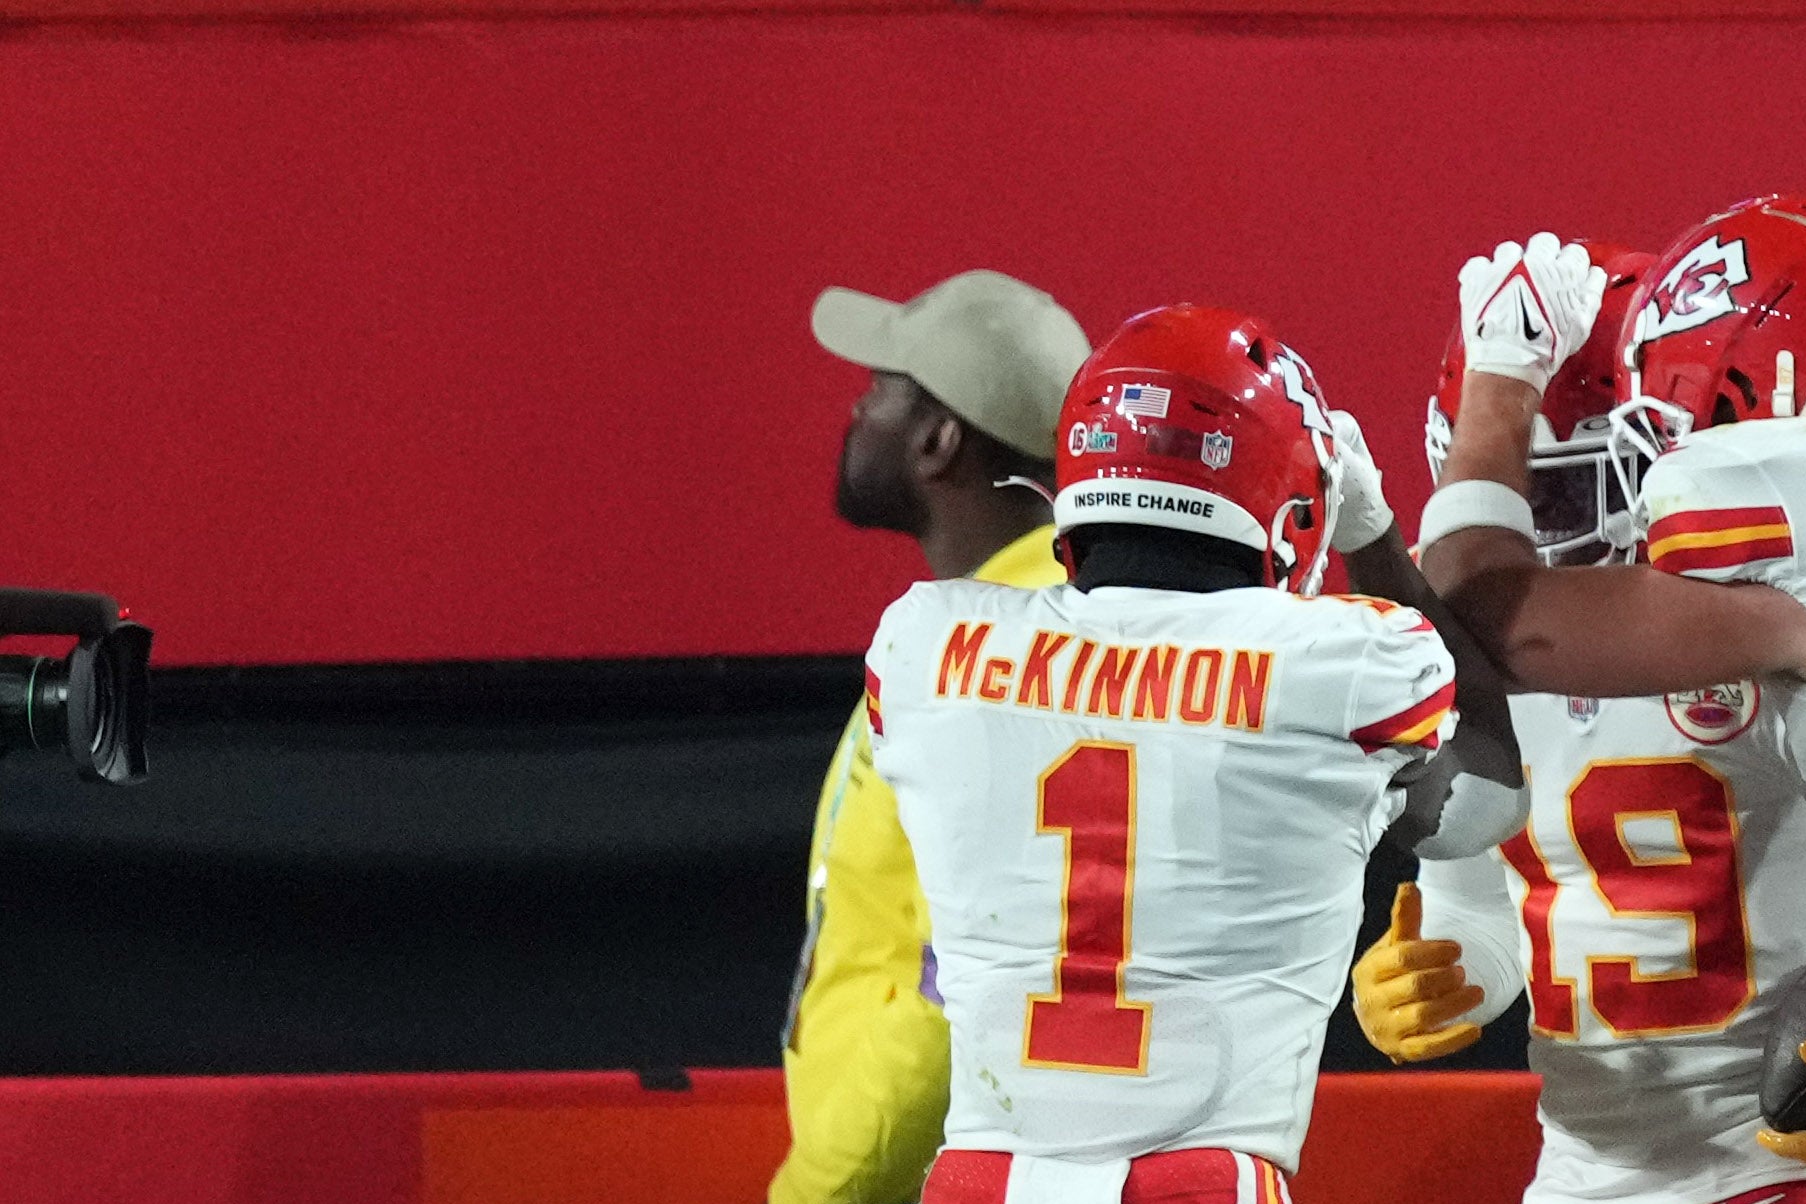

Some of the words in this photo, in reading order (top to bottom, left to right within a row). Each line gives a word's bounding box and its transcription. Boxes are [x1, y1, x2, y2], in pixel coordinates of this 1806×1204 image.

[1074, 491, 1132, 509] INSPIRE
[1137, 493, 1216, 519] CHANGE
[934, 620, 1276, 734] McKINNON
[1020, 738, 1153, 1077] 1
[1499, 755, 1758, 1042] 19
